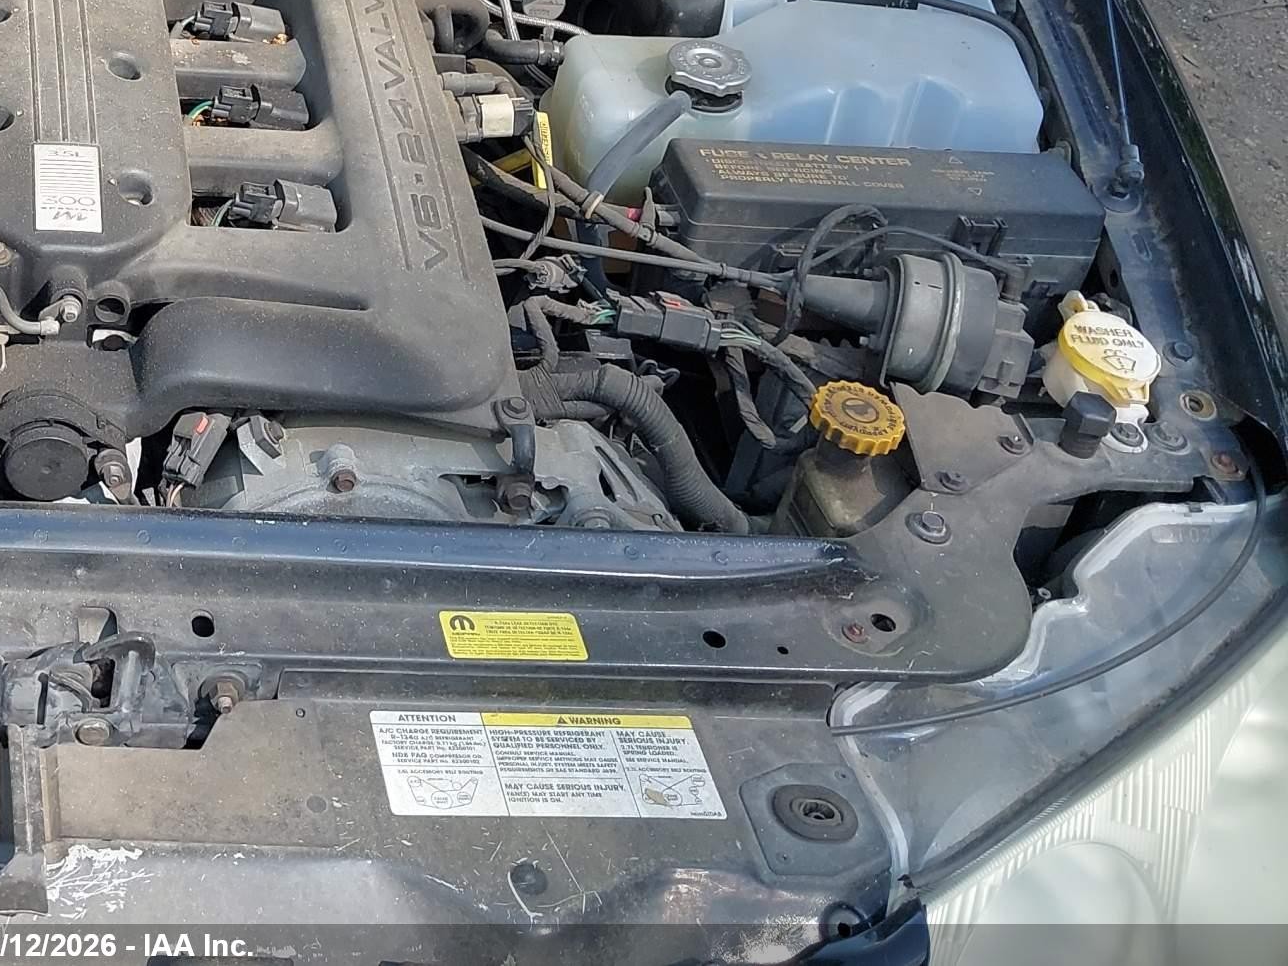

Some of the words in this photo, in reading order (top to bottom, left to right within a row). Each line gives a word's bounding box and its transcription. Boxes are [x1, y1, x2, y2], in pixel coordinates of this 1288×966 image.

[699, 149, 749, 158] FUSE
[772, 152, 830, 163] RELAY
[836, 154, 911, 167] CENTER
[715, 163, 759, 171] BEFORE
[766, 166, 833, 174] SERVICING
[796, 162, 848, 170] BATTERY
[718, 169, 769, 177] ALWAYS
[721, 174, 785, 183] PROPERLY
[863, 181, 904, 189] COVER
[41, 195, 96, 206] 300
[1074, 324, 1133, 338] WASHER
[1071, 334, 1109, 346] FLUID
[1112, 338, 1144, 348] ONLY
[398, 714, 457, 723] ATTENTION
[567, 716, 621, 725] WARNING
[616, 730, 635, 738] MAY
